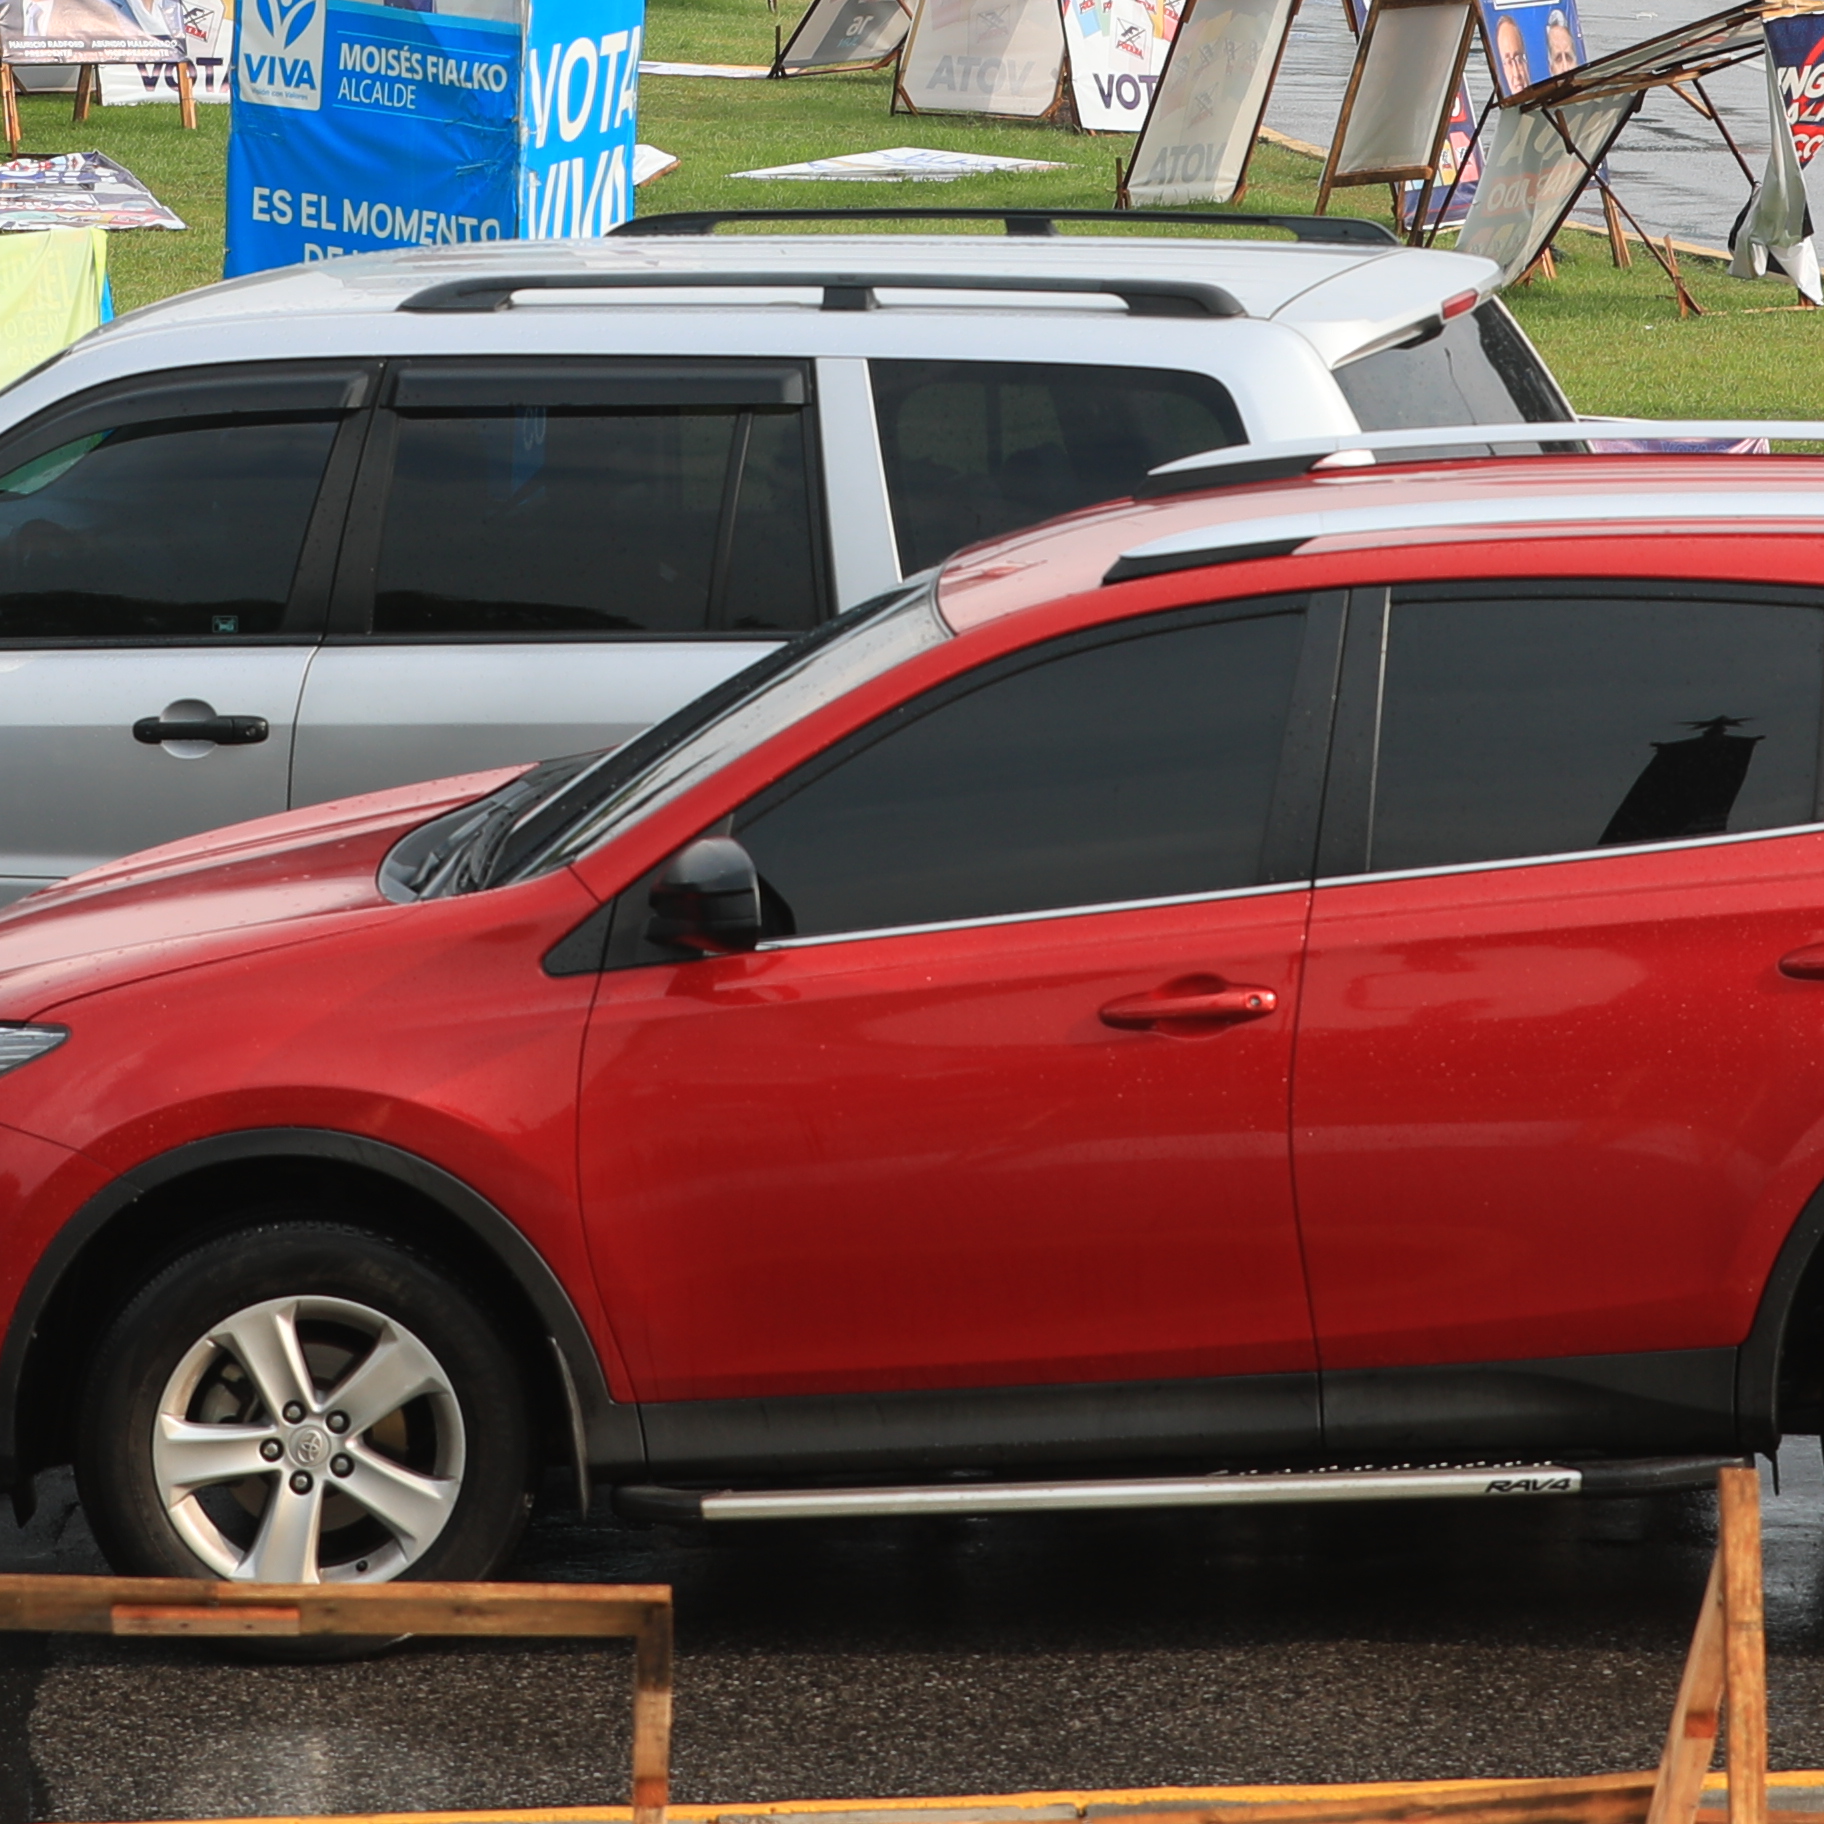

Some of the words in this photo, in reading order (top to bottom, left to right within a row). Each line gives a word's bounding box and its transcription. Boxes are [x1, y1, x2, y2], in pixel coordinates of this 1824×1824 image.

[242, 51, 318, 92] VIVA
[338, 42, 424, 82] MOISÉS
[426, 54, 508, 94] FIALKO
[529, 25, 642, 148] VOTA
[336, 76, 417, 110] ALCALDE
[1093, 72, 1160, 111] VOT
[252, 186, 294, 226] ES
[300, 192, 337, 231] EL
[343, 198, 502, 246] MOMENTO
